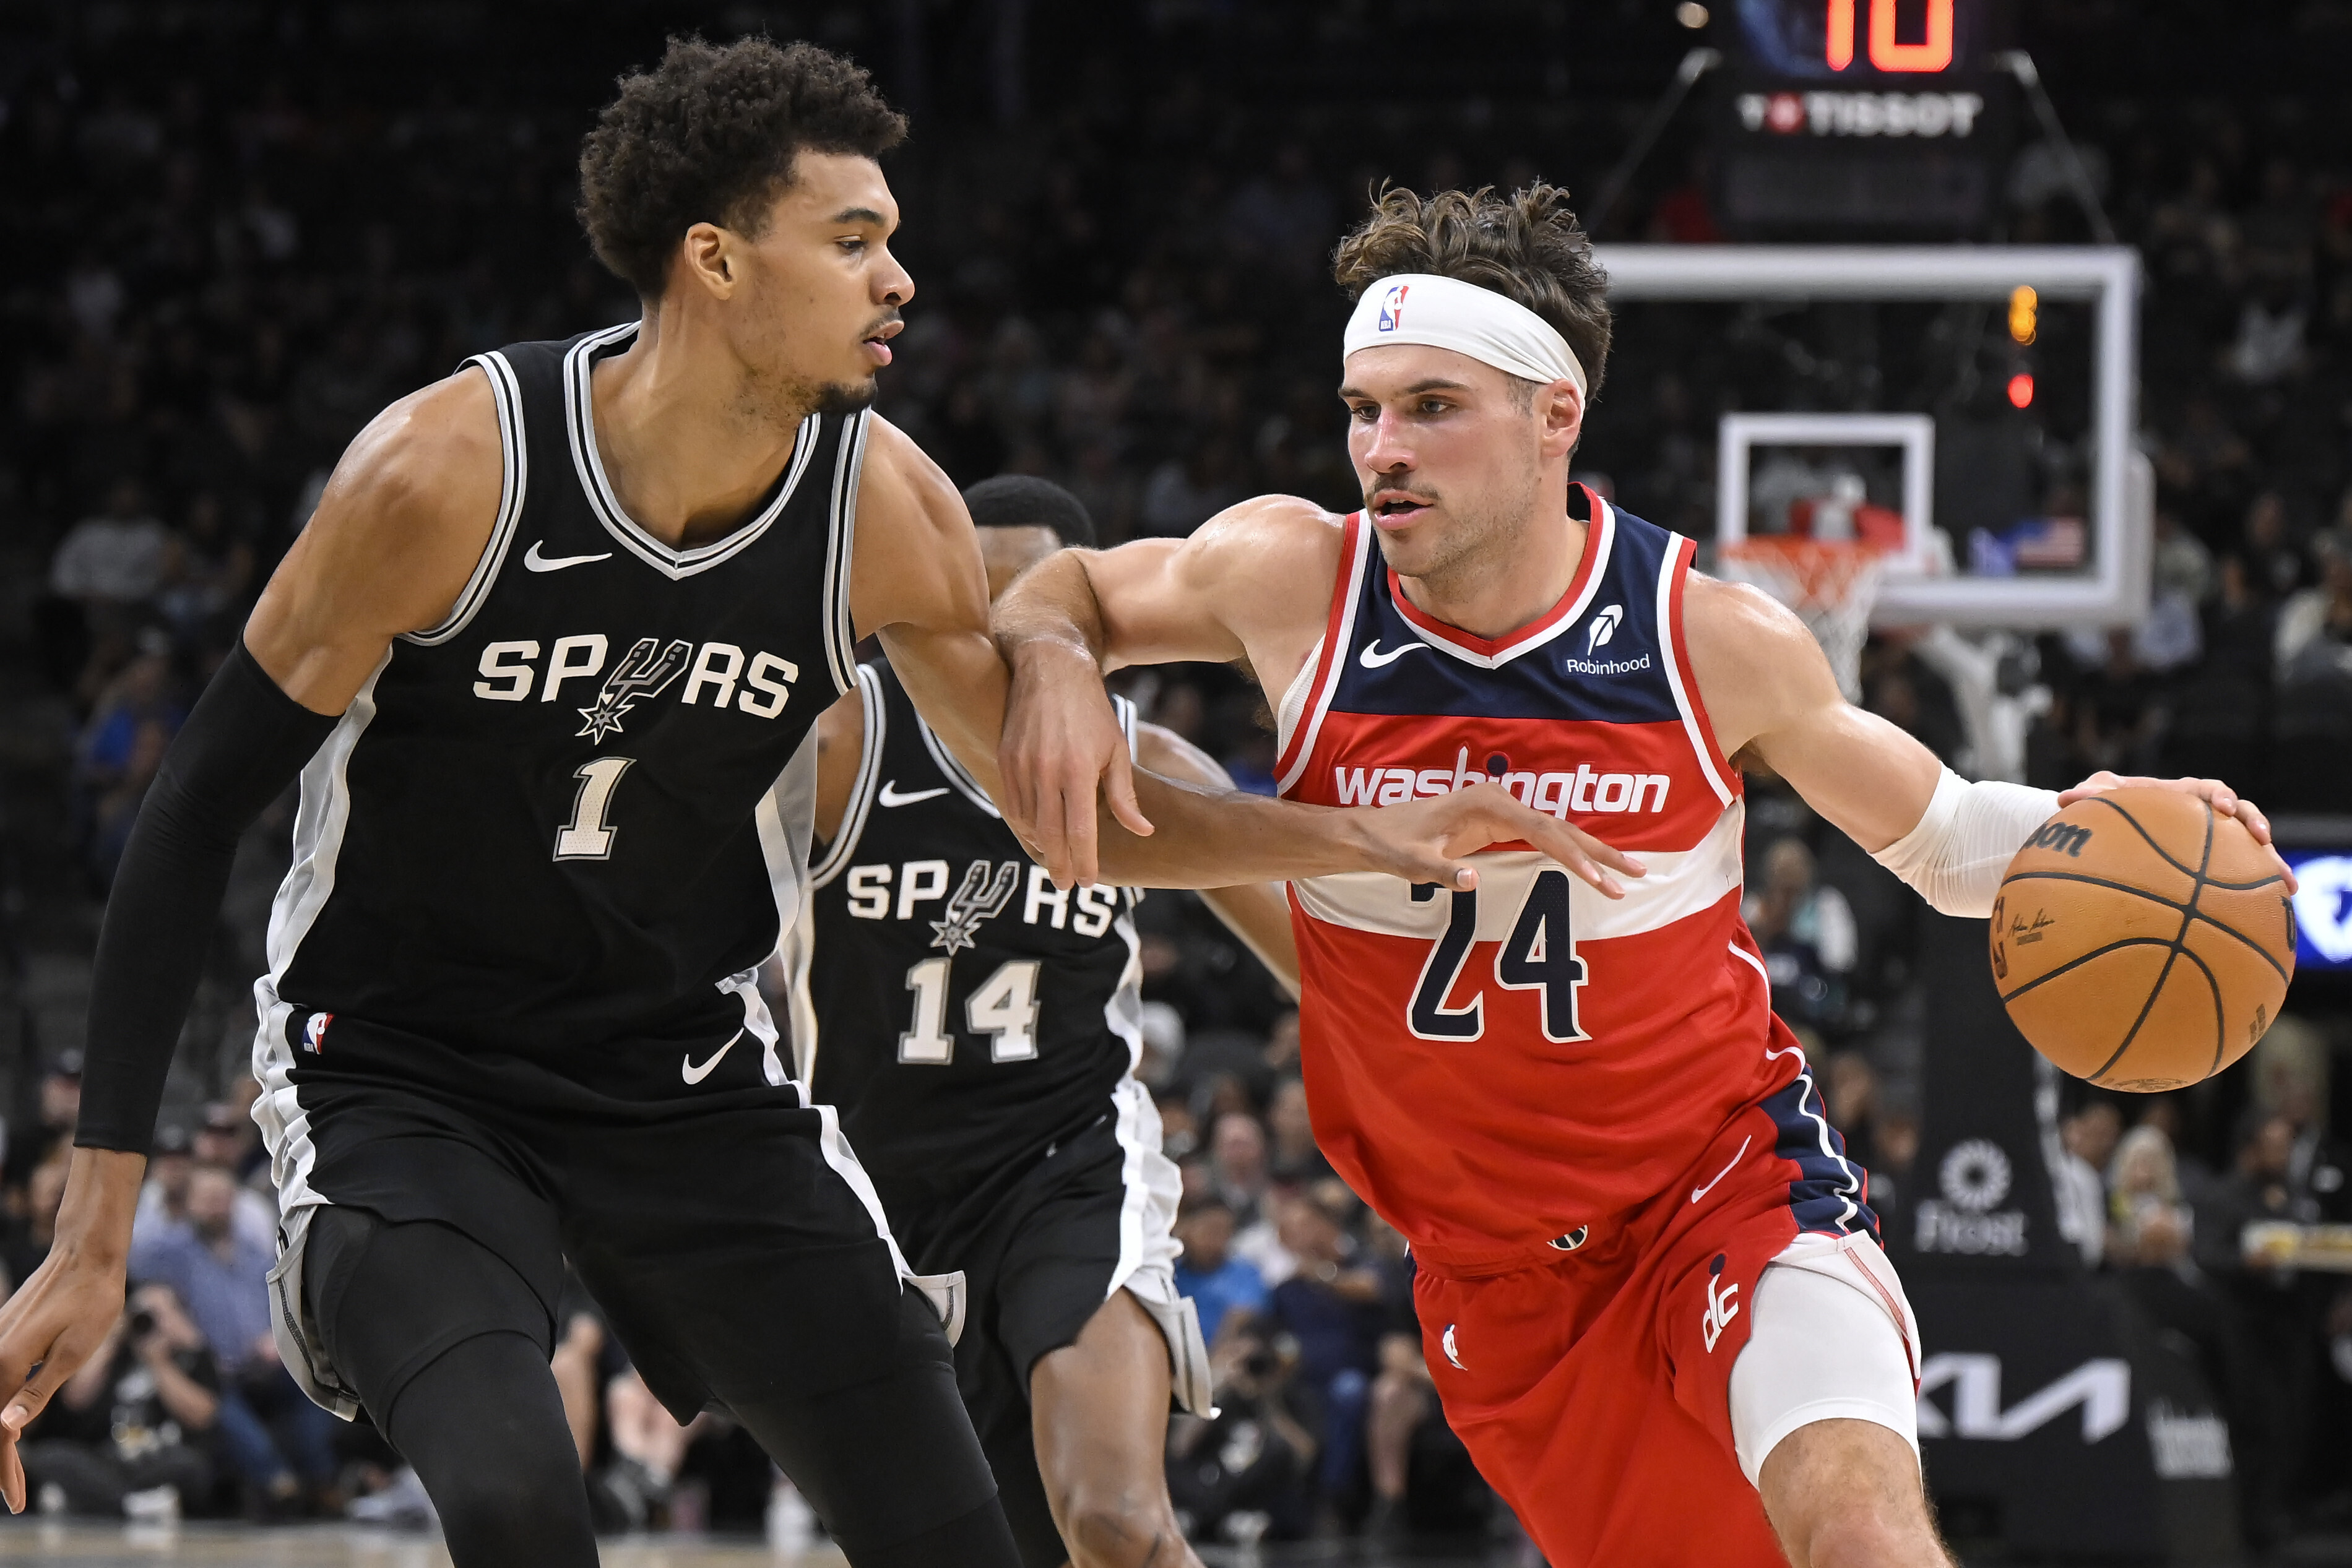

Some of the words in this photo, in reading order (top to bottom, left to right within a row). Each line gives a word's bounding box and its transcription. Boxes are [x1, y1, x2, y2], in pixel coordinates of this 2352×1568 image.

[1380, 319, 1391, 329] NBA
[473, 634, 799, 745] SPURS
[1567, 653, 1650, 675] Robinhood
[552, 756, 637, 861] 1
[1406, 864, 1593, 1044] 24
[897, 957, 1042, 1065] 14
